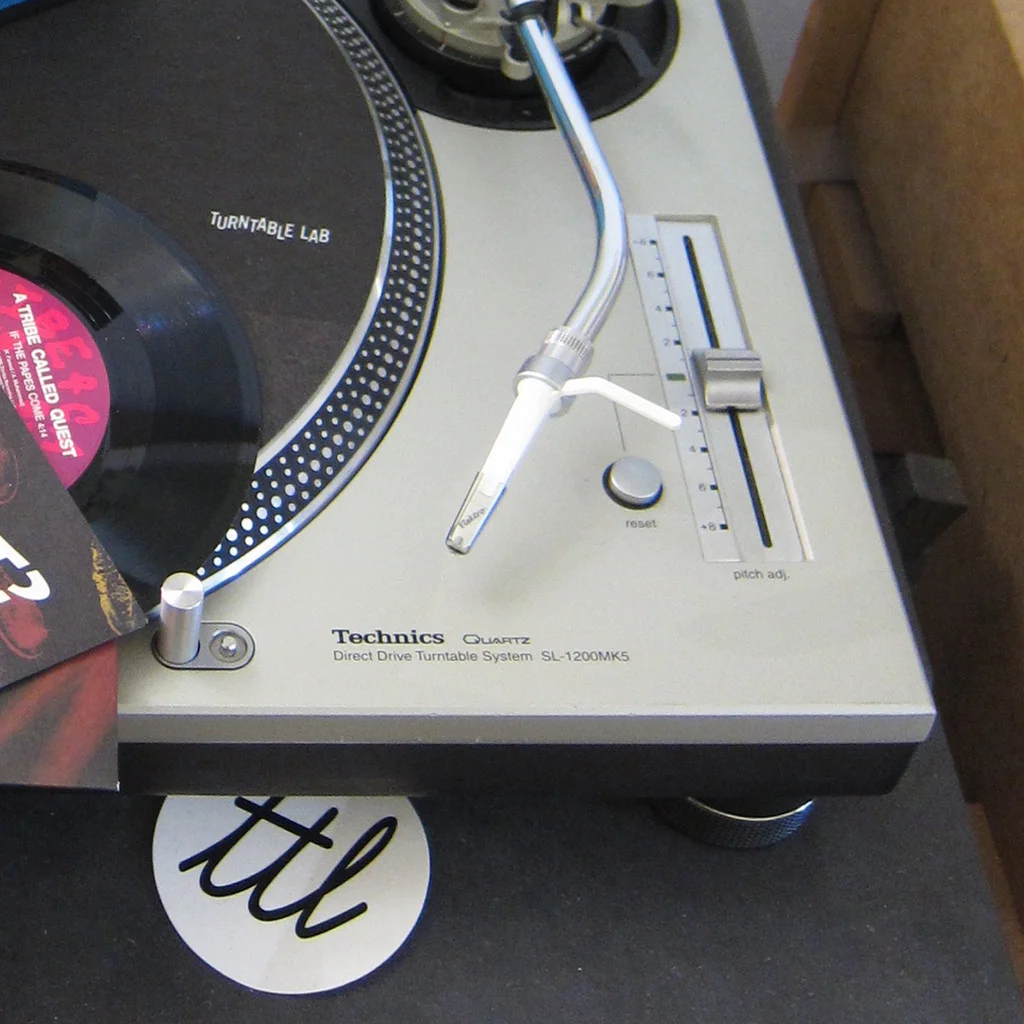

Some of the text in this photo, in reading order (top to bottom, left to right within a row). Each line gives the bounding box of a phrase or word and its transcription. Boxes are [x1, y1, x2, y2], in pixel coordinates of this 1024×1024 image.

[299, 225, 331, 244] LAB
[8, 330, 20, 340] IF
[13, 339, 27, 361] THE
[12, 292, 78, 459] A TRIBE CALLED QUEST
[17, 360, 36, 392] PAPES
[27, 391, 46, 423] COME
[626, 519, 657, 529] reset
[733, 568, 764, 581] pitch
[331, 628, 445, 645] Technics
[333, 650, 630, 665] Direct Drive Turntable System SL-1200MK5
